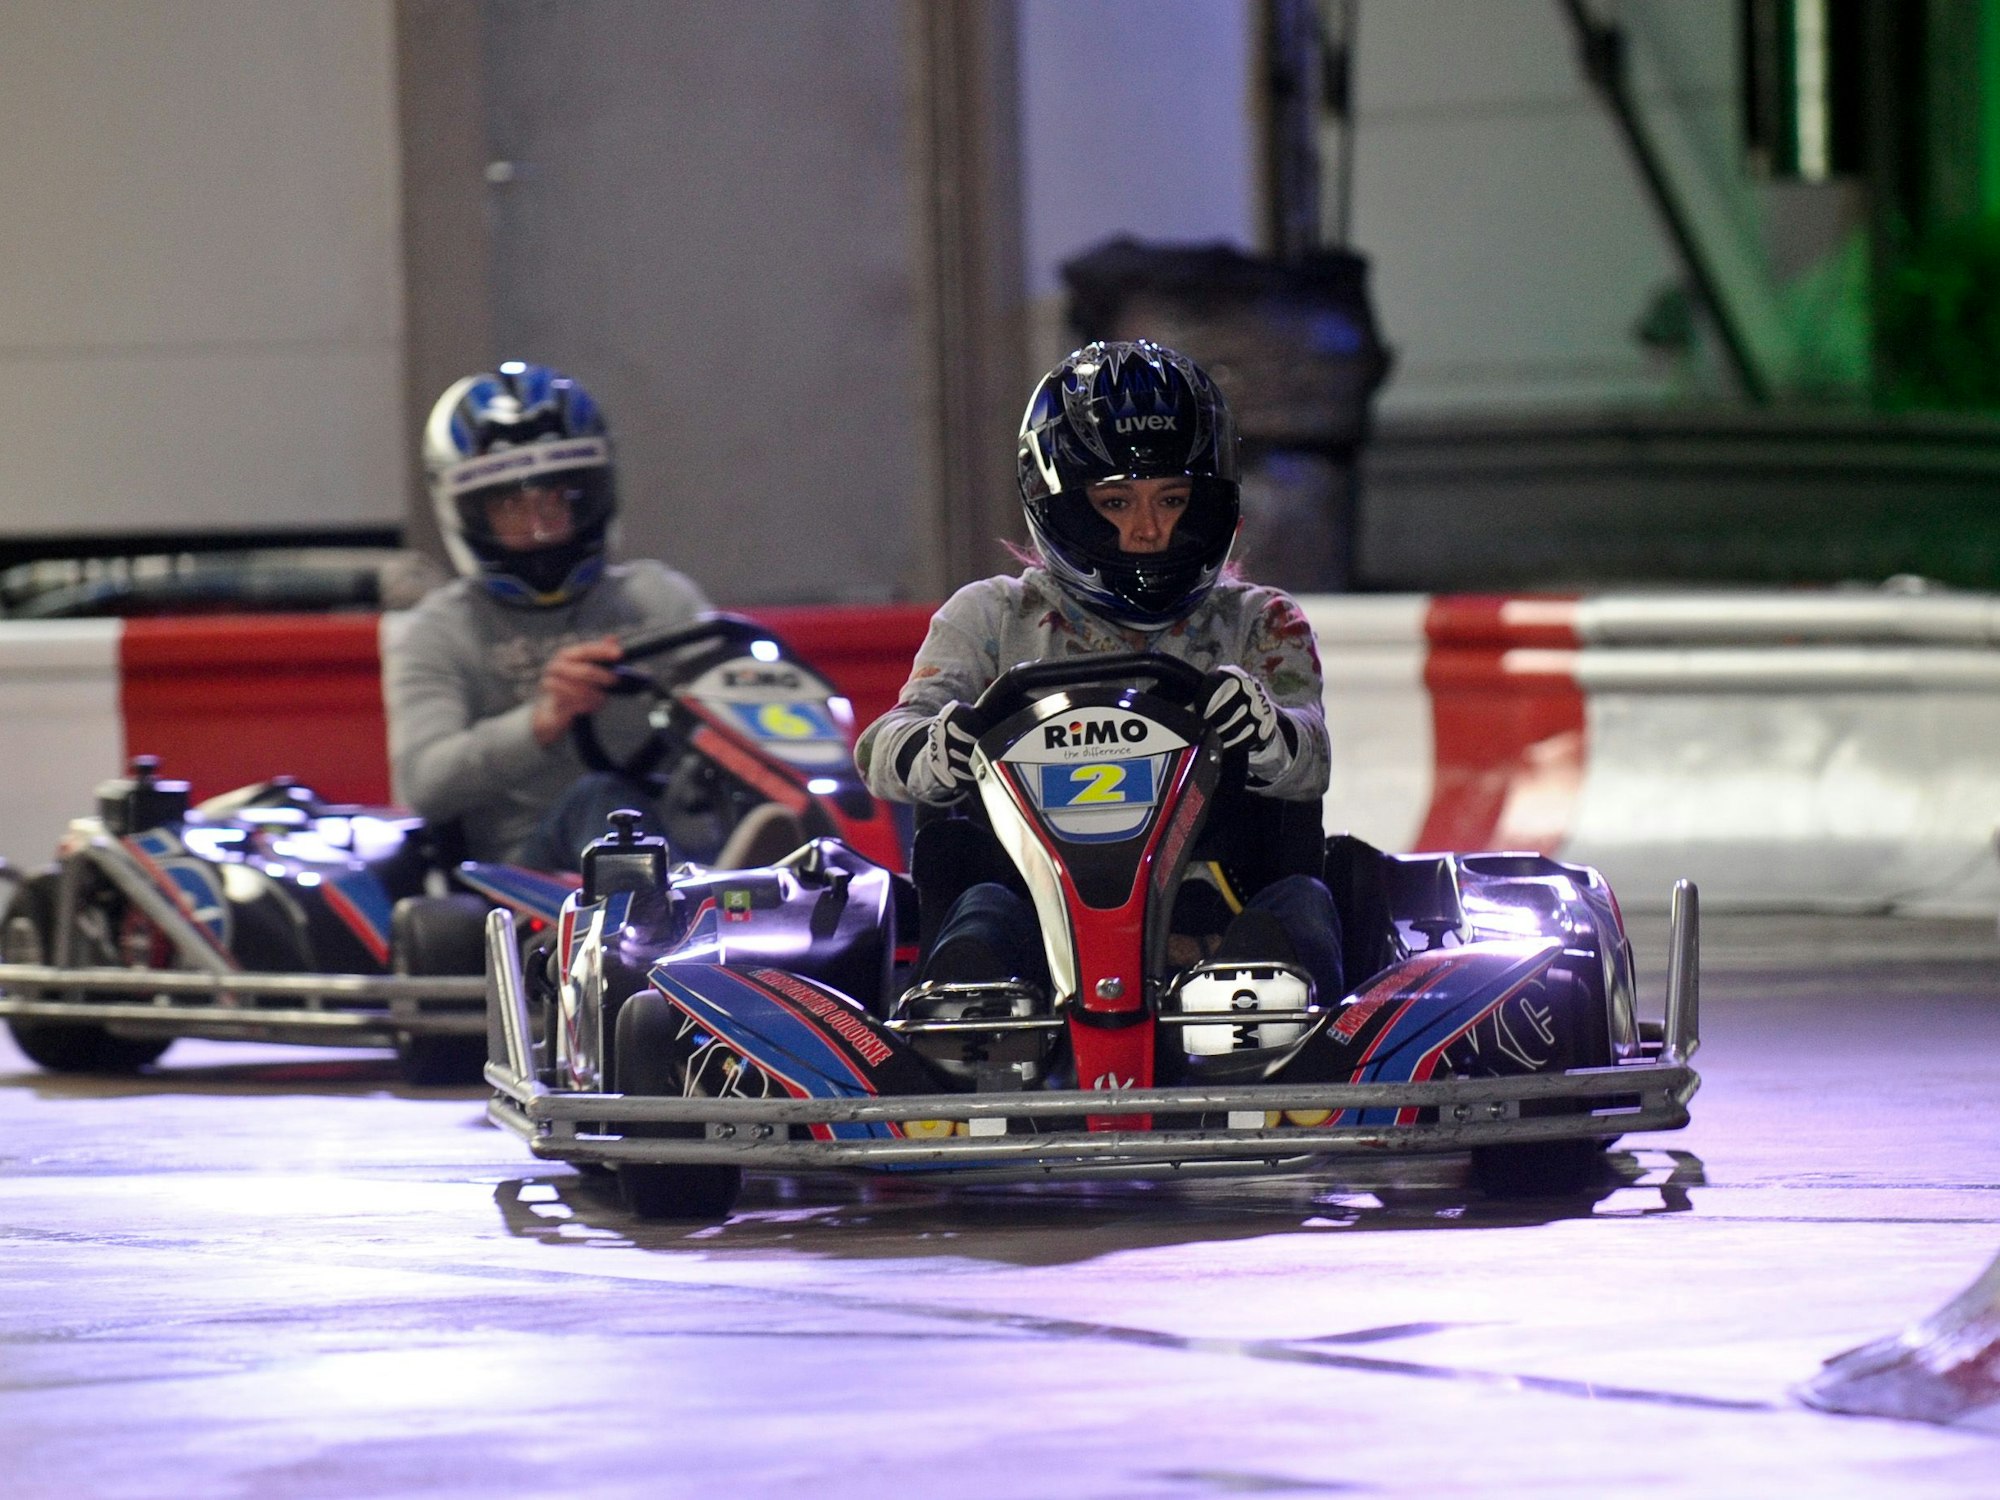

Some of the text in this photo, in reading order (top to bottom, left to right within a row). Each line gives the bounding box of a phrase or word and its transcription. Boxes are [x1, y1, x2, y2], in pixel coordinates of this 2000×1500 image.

[1115, 415, 1177, 434] uvex
[759, 703, 813, 738] 6
[1063, 745, 1132, 760] the difference
[1066, 763, 1127, 806] 2
[823, 1009, 894, 1068] COLOGNE
